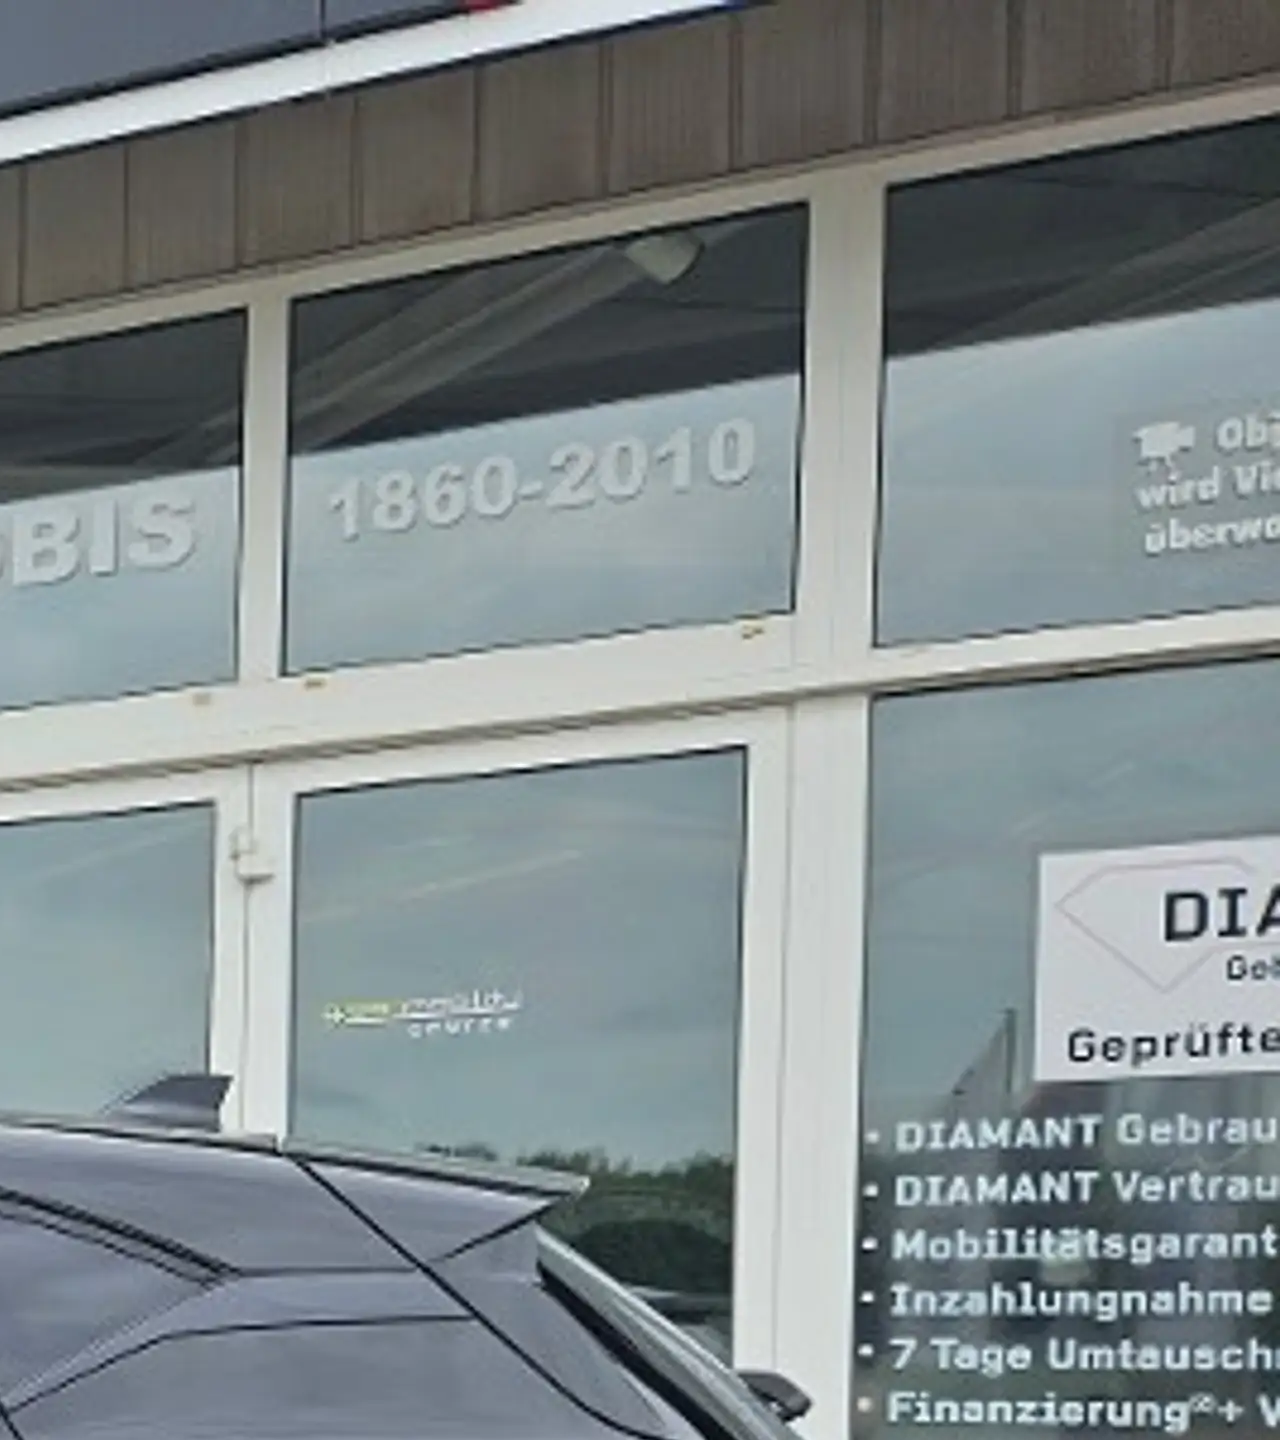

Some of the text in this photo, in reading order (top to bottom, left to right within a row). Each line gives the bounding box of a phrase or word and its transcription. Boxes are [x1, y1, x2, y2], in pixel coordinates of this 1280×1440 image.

[331, 418, 754, 541] 1860-2010
[1068, 1021, 1280, 1068] Geprüfte
[895, 1112, 1278, 1152] DIAMANT Gebrau
[895, 1170, 1280, 1207] DIAMANT Vertrau
[892, 1224, 1278, 1265] Mobilitätsgarant
[890, 1281, 1274, 1322] Inzahlungnahme
[889, 1338, 918, 1371] 7
[930, 1337, 1033, 1379] Tage
